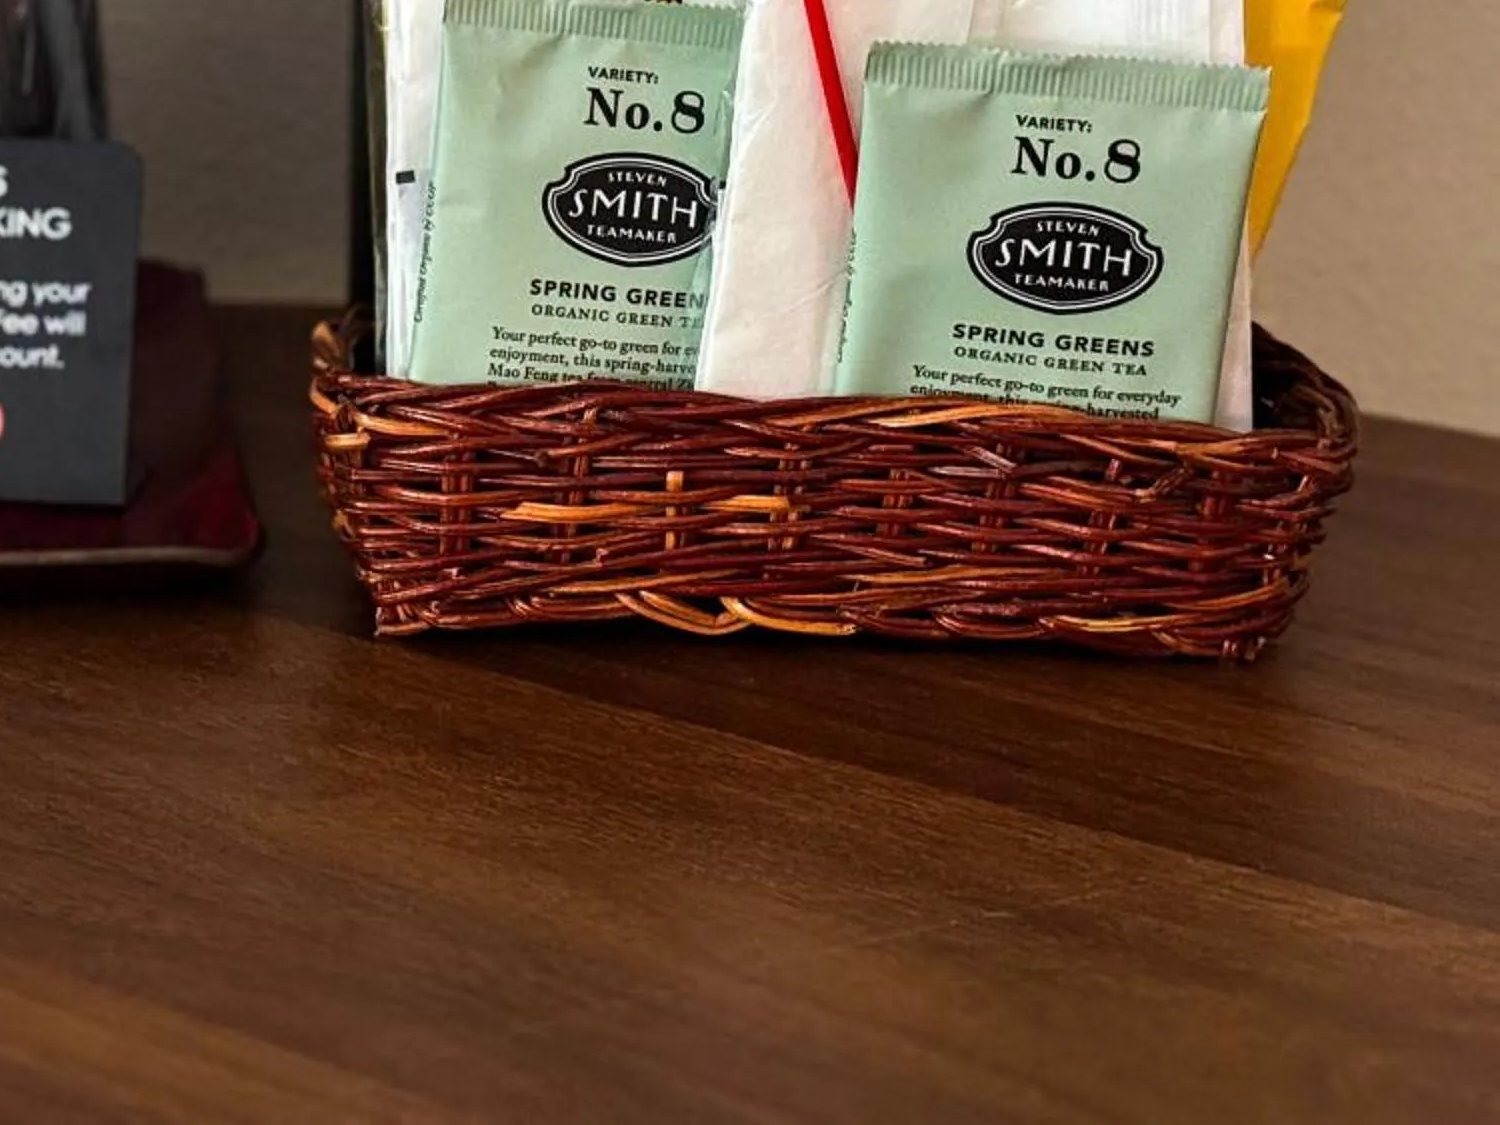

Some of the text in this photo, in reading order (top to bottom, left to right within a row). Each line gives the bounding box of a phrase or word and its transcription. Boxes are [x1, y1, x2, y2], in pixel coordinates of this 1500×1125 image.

[587, 65, 660, 84] VARIETY:
[1015, 114, 1093, 134] VARIETY:
[607, 171, 669, 188] STEVEN
[568, 188, 698, 229] SMITH
[587, 224, 678, 244] TEAMAKER
[1036, 220, 1100, 237] STEVEN
[995, 238, 1132, 277] SMITH
[32, 281, 91, 306] your
[529, 278, 706, 310] SPRING GREEN
[1014, 273, 1109, 292] TEAMAKER
[43, 309, 87, 336] will
[531, 304, 610, 322] ORGANIC
[616, 312, 673, 328] GREEN
[492, 325, 526, 342] Your
[528, 331, 578, 347] perfect
[579, 338, 617, 352] go-to
[619, 341, 659, 355] green
[661, 341, 681, 356] for
[952, 323, 1155, 357] SPRING GREENS
[489, 346, 569, 368] enjoyment,
[573, 352, 601, 368] this
[954, 346, 1147, 376] ORGANIC GREEN TEA
[487, 362, 520, 379] Mao
[913, 364, 1182, 408] Your perfect go-to green for everyday
